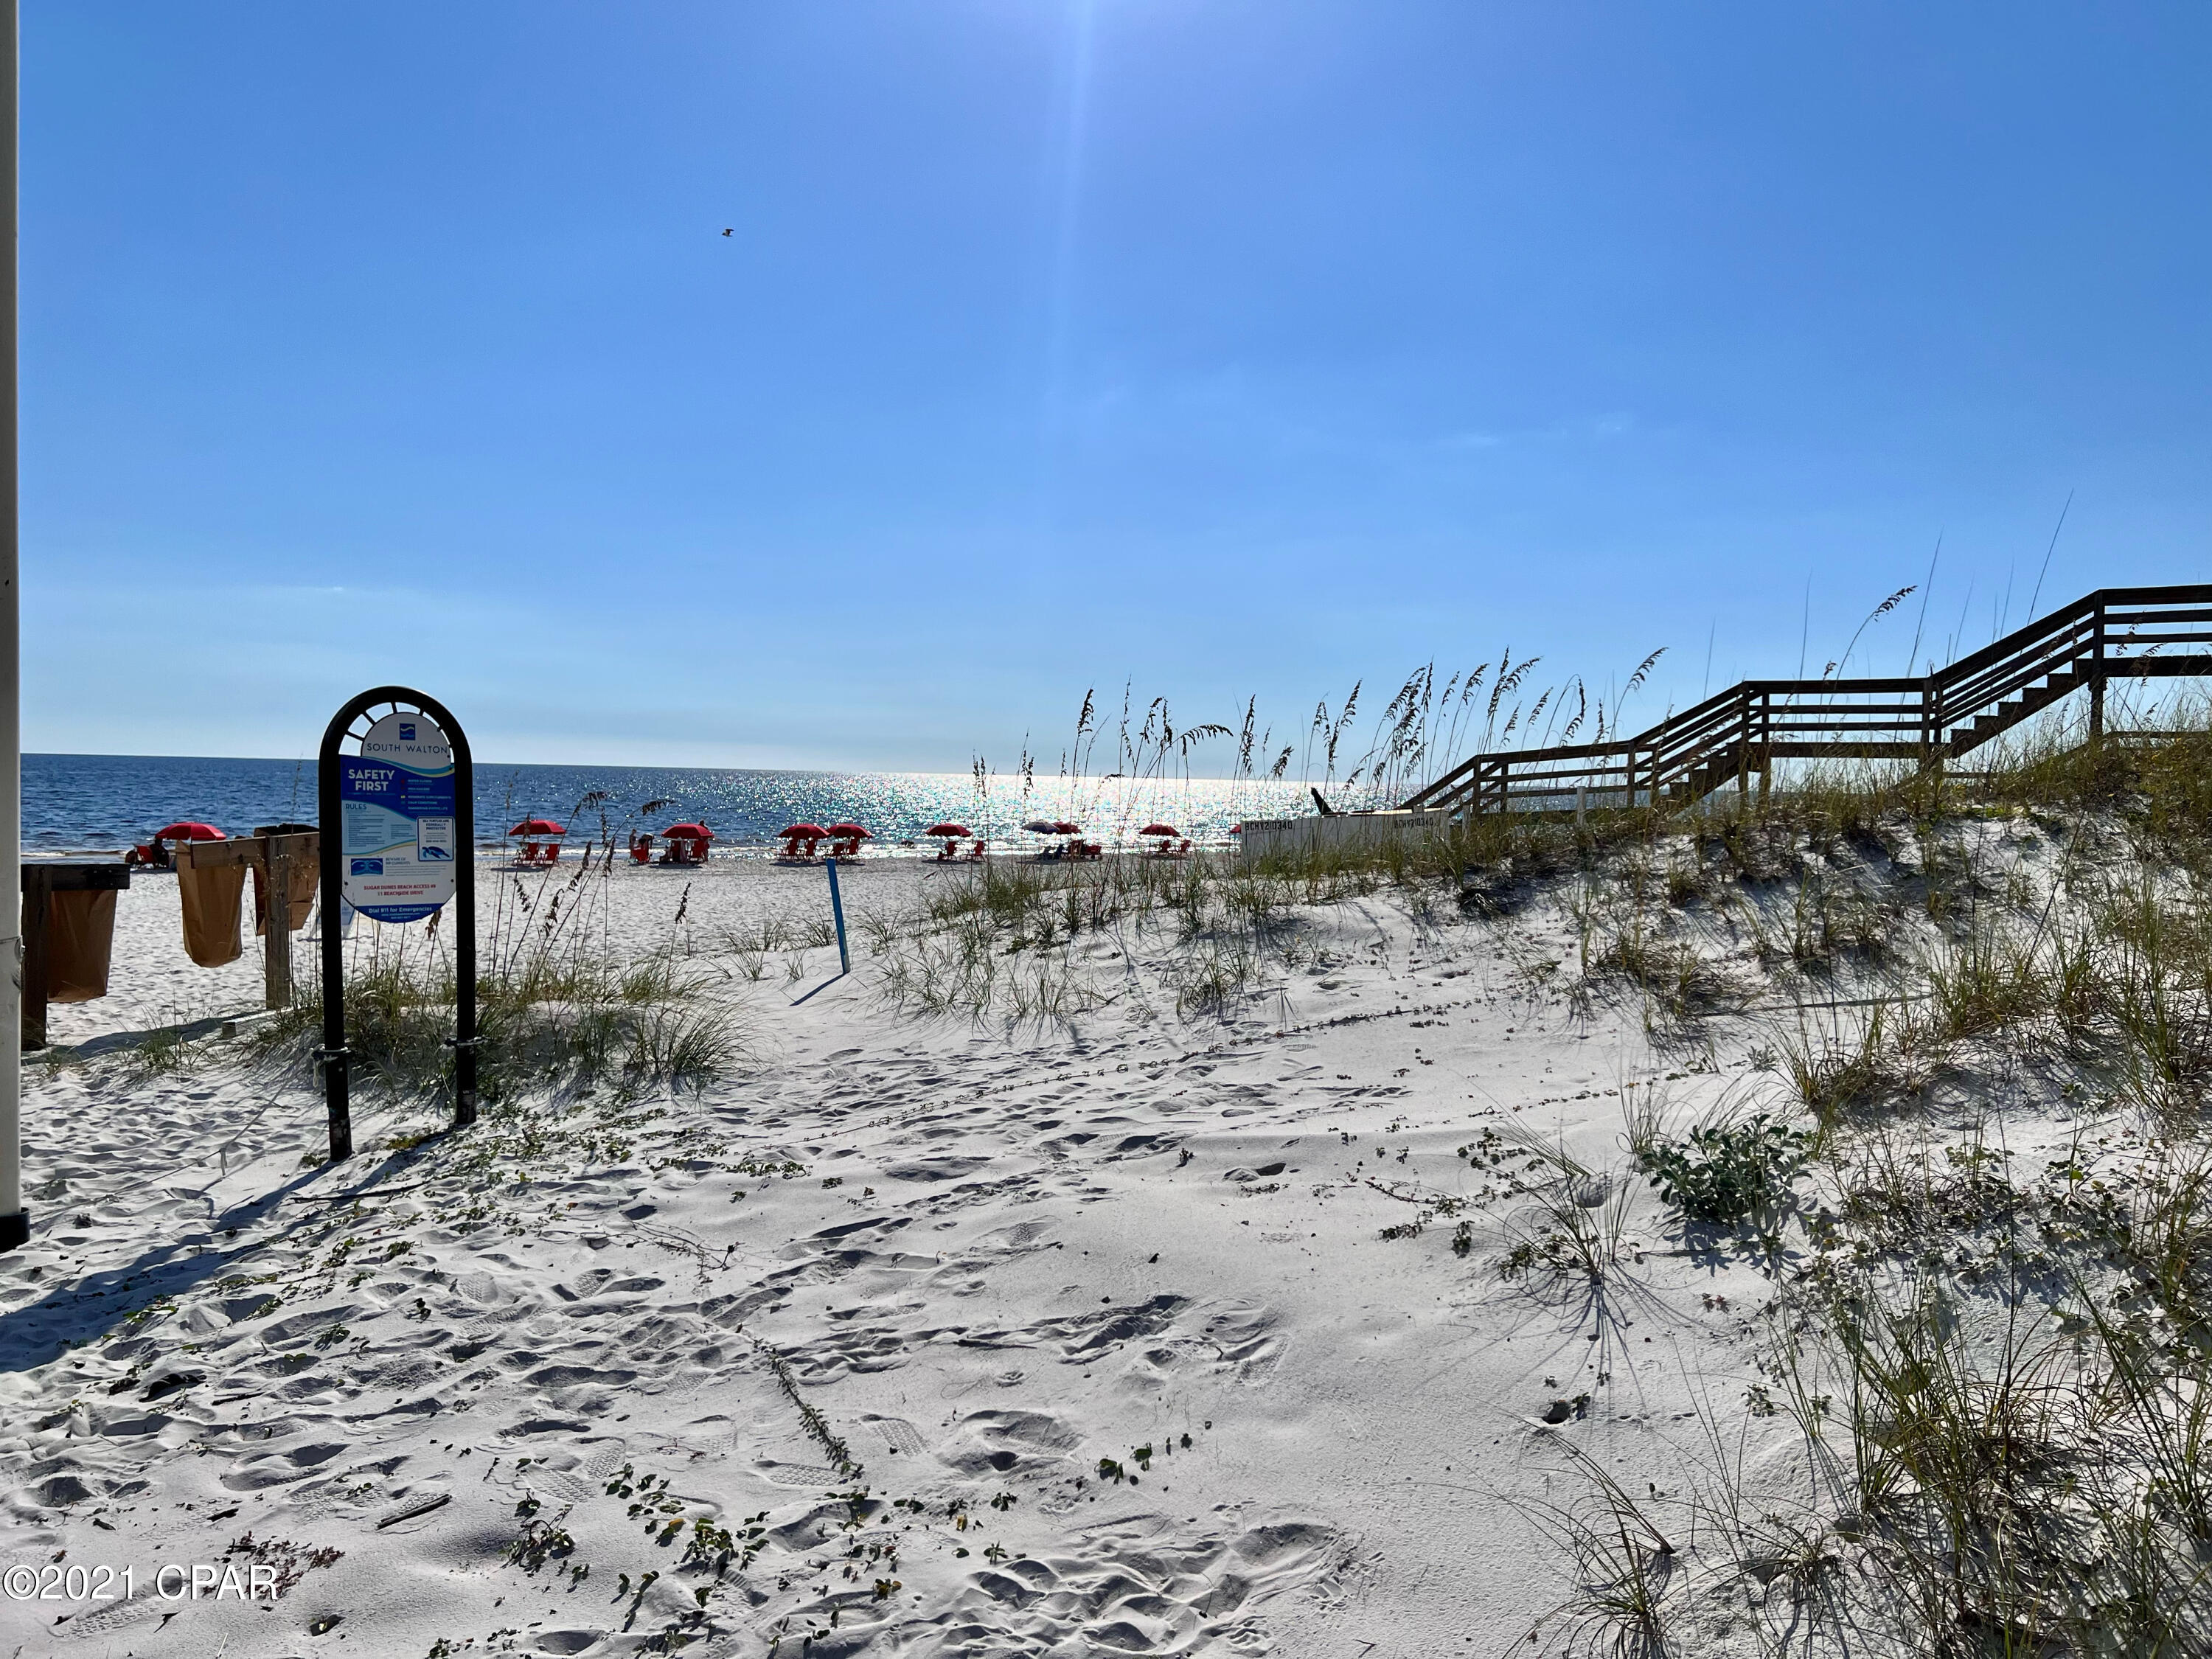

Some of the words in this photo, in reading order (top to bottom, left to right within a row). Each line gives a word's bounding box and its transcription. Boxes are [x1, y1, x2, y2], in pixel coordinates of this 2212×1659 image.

[366, 742, 400, 752] SOUTH
[406, 744, 448, 754] WALTON
[348, 768, 395, 780] SAFETY
[355, 780, 389, 791] FIRST
